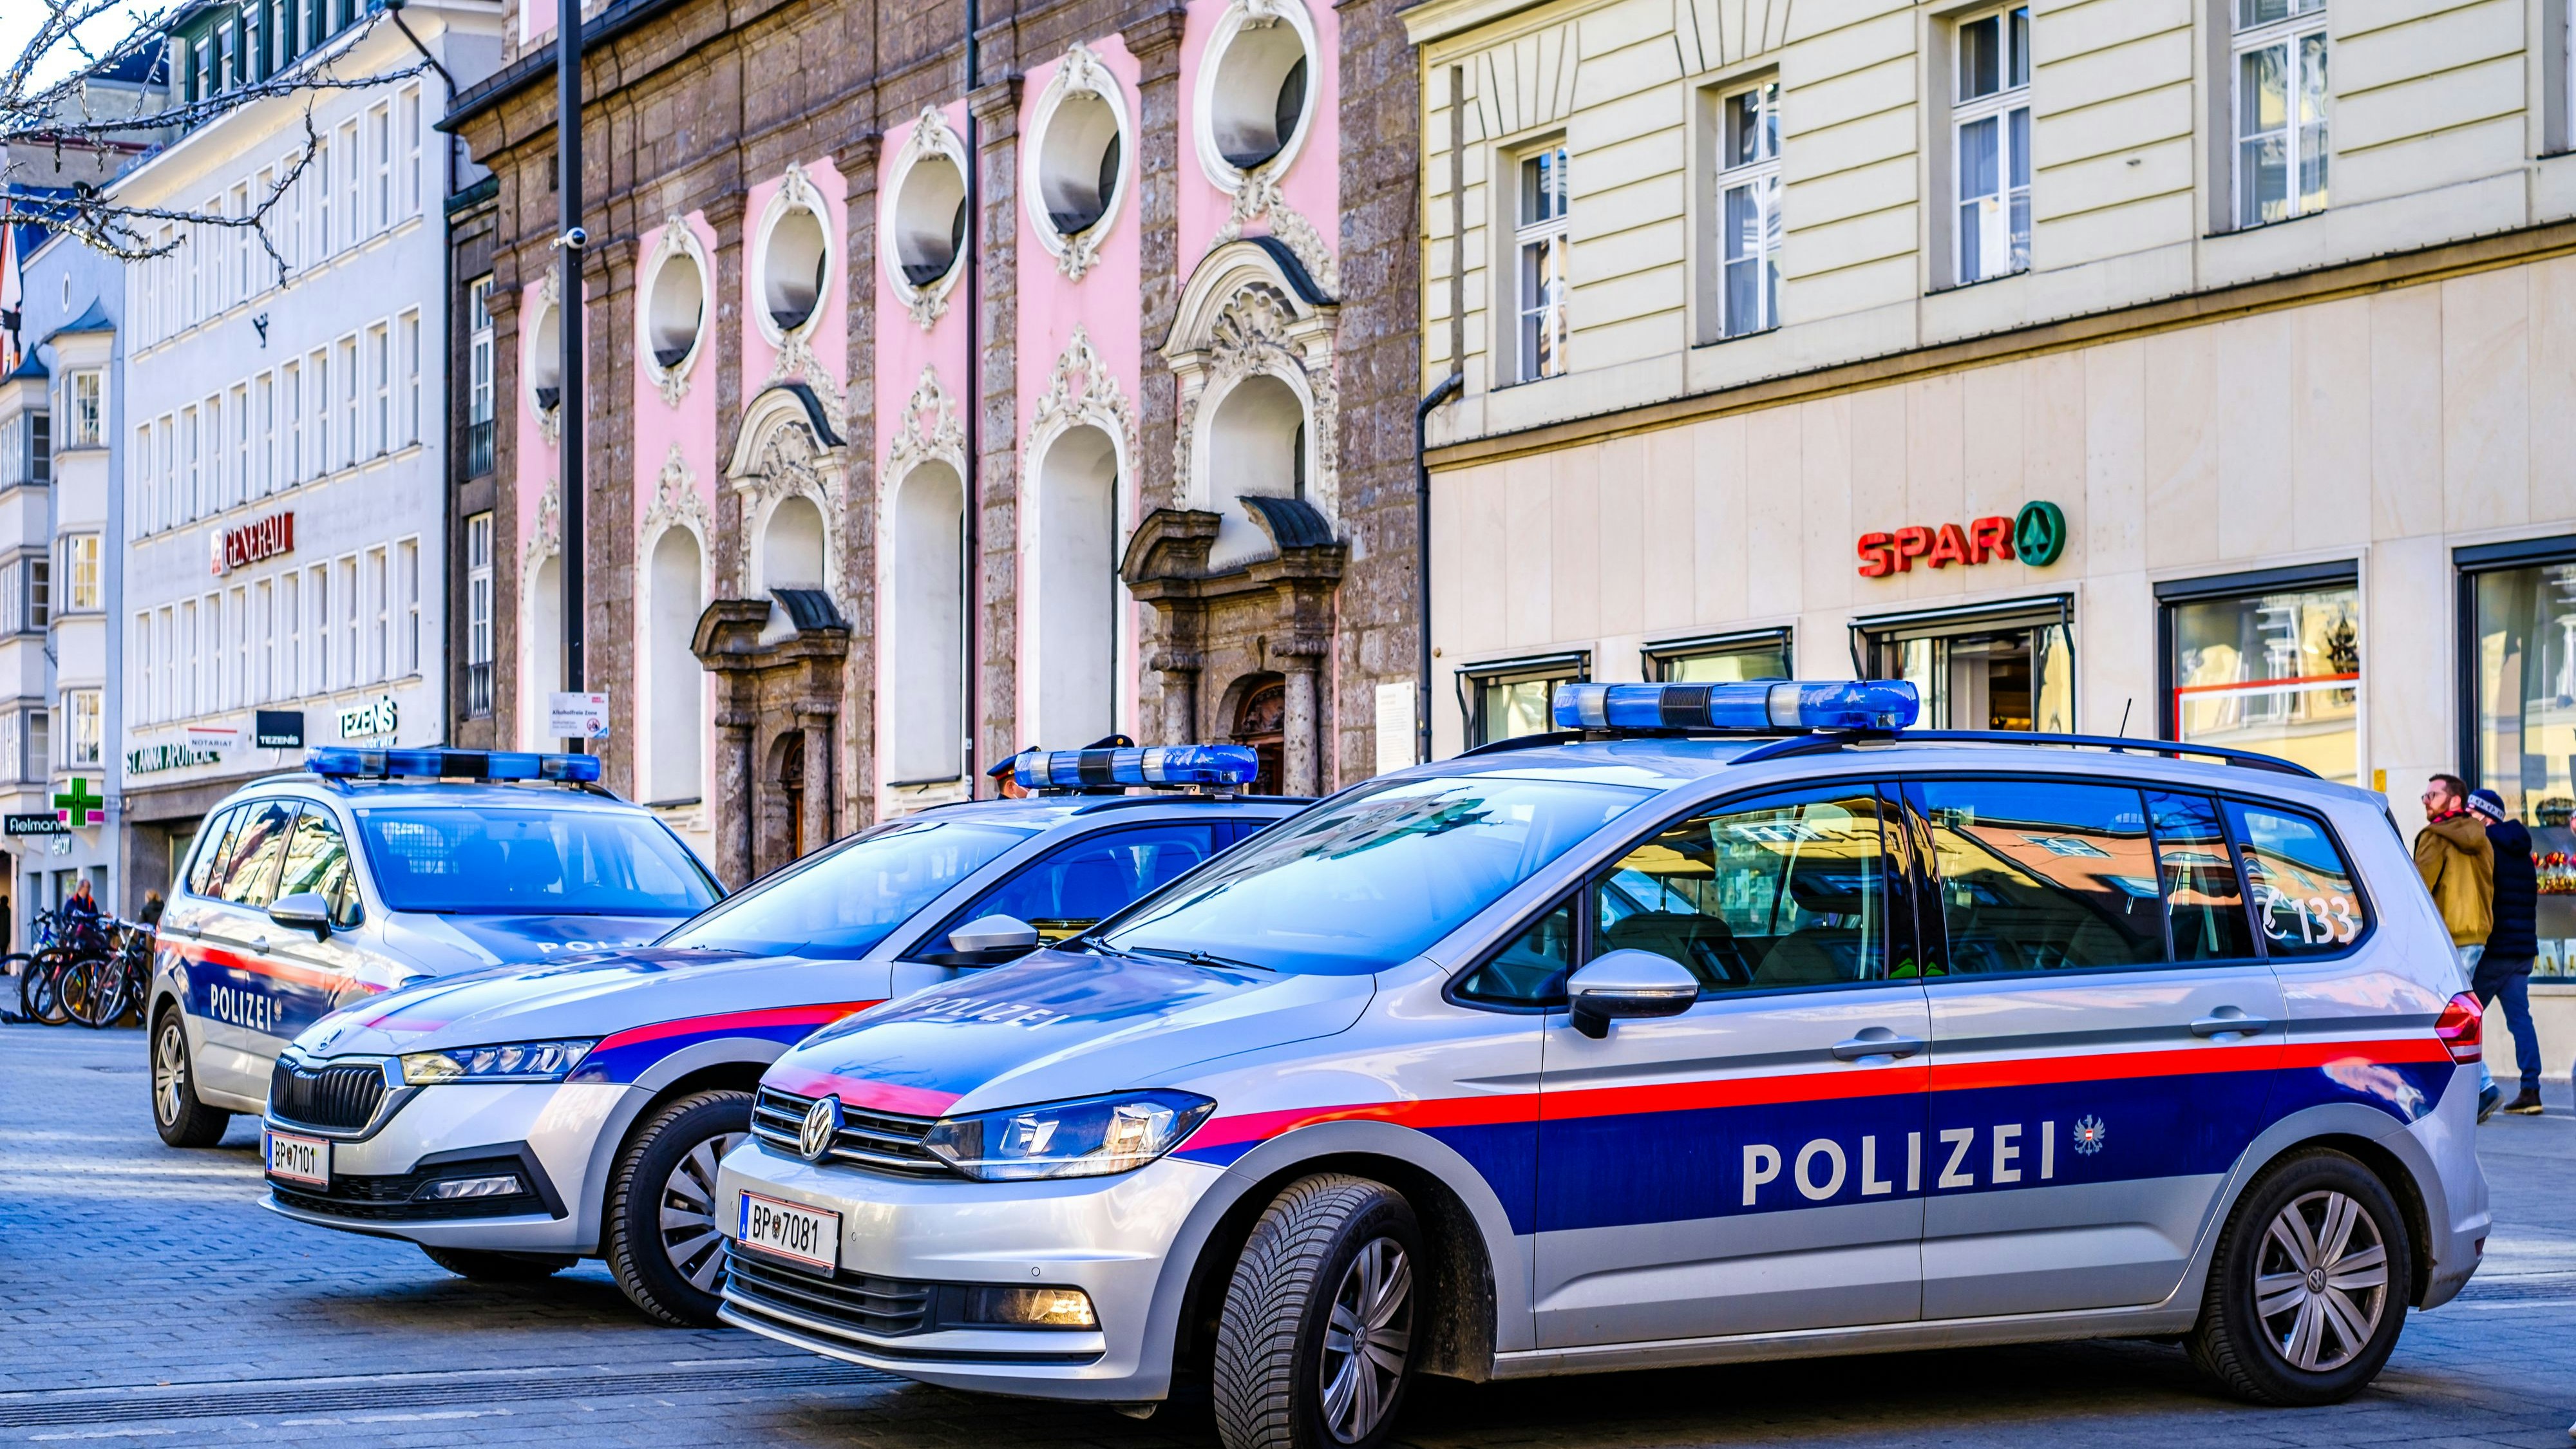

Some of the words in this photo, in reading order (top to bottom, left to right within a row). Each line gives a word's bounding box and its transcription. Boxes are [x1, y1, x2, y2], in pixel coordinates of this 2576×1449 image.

[224, 513, 287, 569] GENERALI
[1858, 516, 2016, 578] SPAR
[138, 746, 163, 773] ANNA
[191, 739, 232, 748] NOTARIAT
[2291, 896, 2356, 944] 133
[211, 983, 271, 1032] POLIZEI
[902, 998, 1071, 1031] POLIZEI
[292, 1144, 315, 1175] 7101
[1742, 1121, 2054, 1206] POLIZEI
[741, 1223, 746, 1235] A
[781, 1211, 819, 1255] 7081
